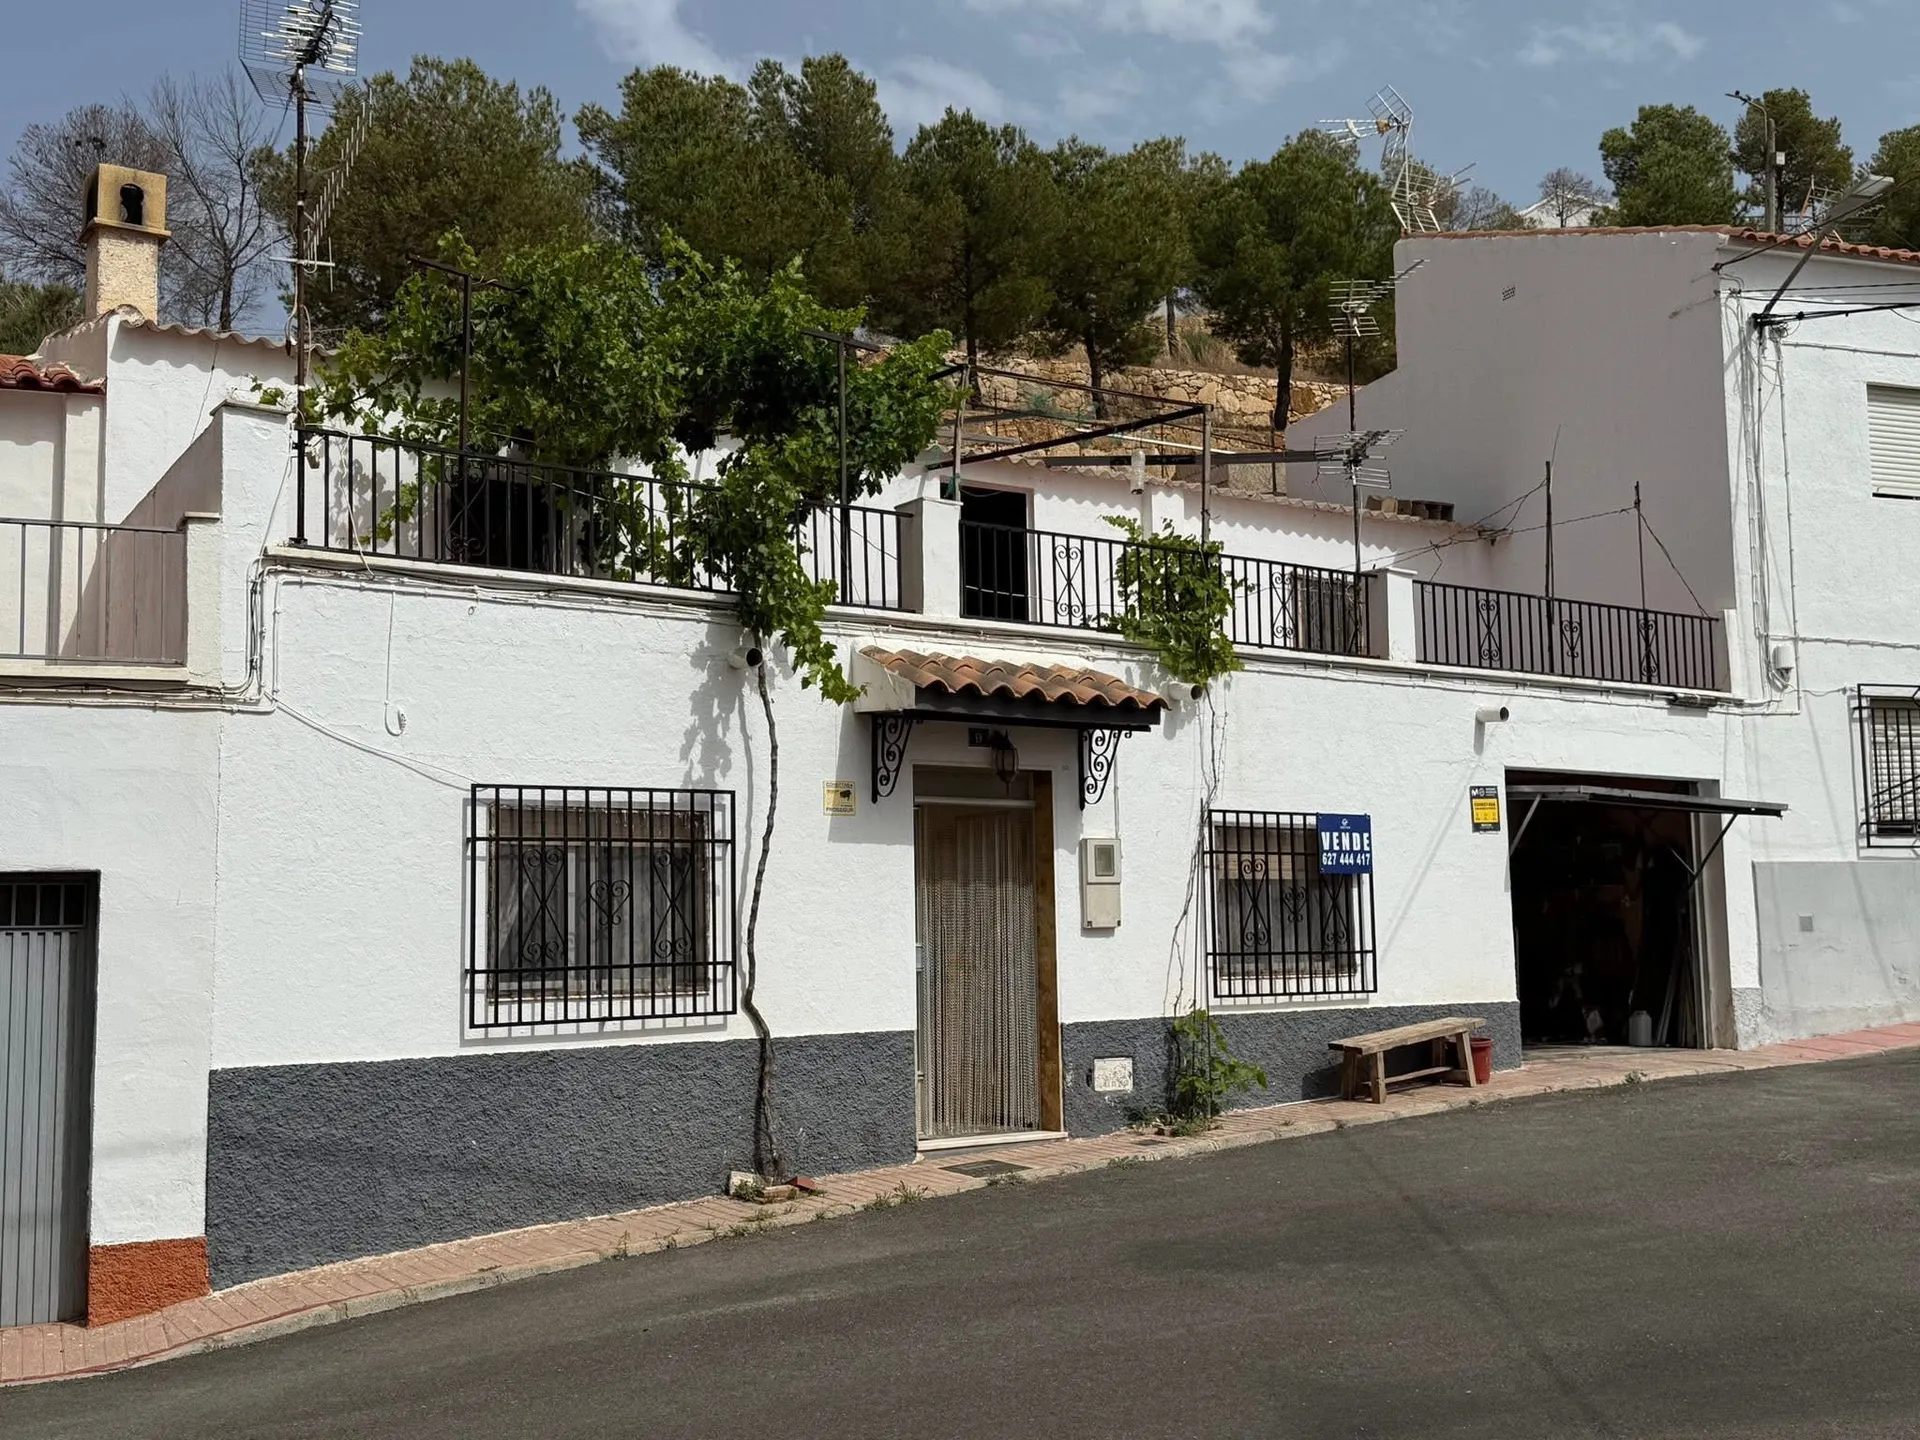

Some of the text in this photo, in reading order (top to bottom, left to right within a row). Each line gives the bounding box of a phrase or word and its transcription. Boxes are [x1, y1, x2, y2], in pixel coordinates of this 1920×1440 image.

[1321, 831, 1370, 851] VENDE
[1322, 852, 1370, 866] 627 444 417
